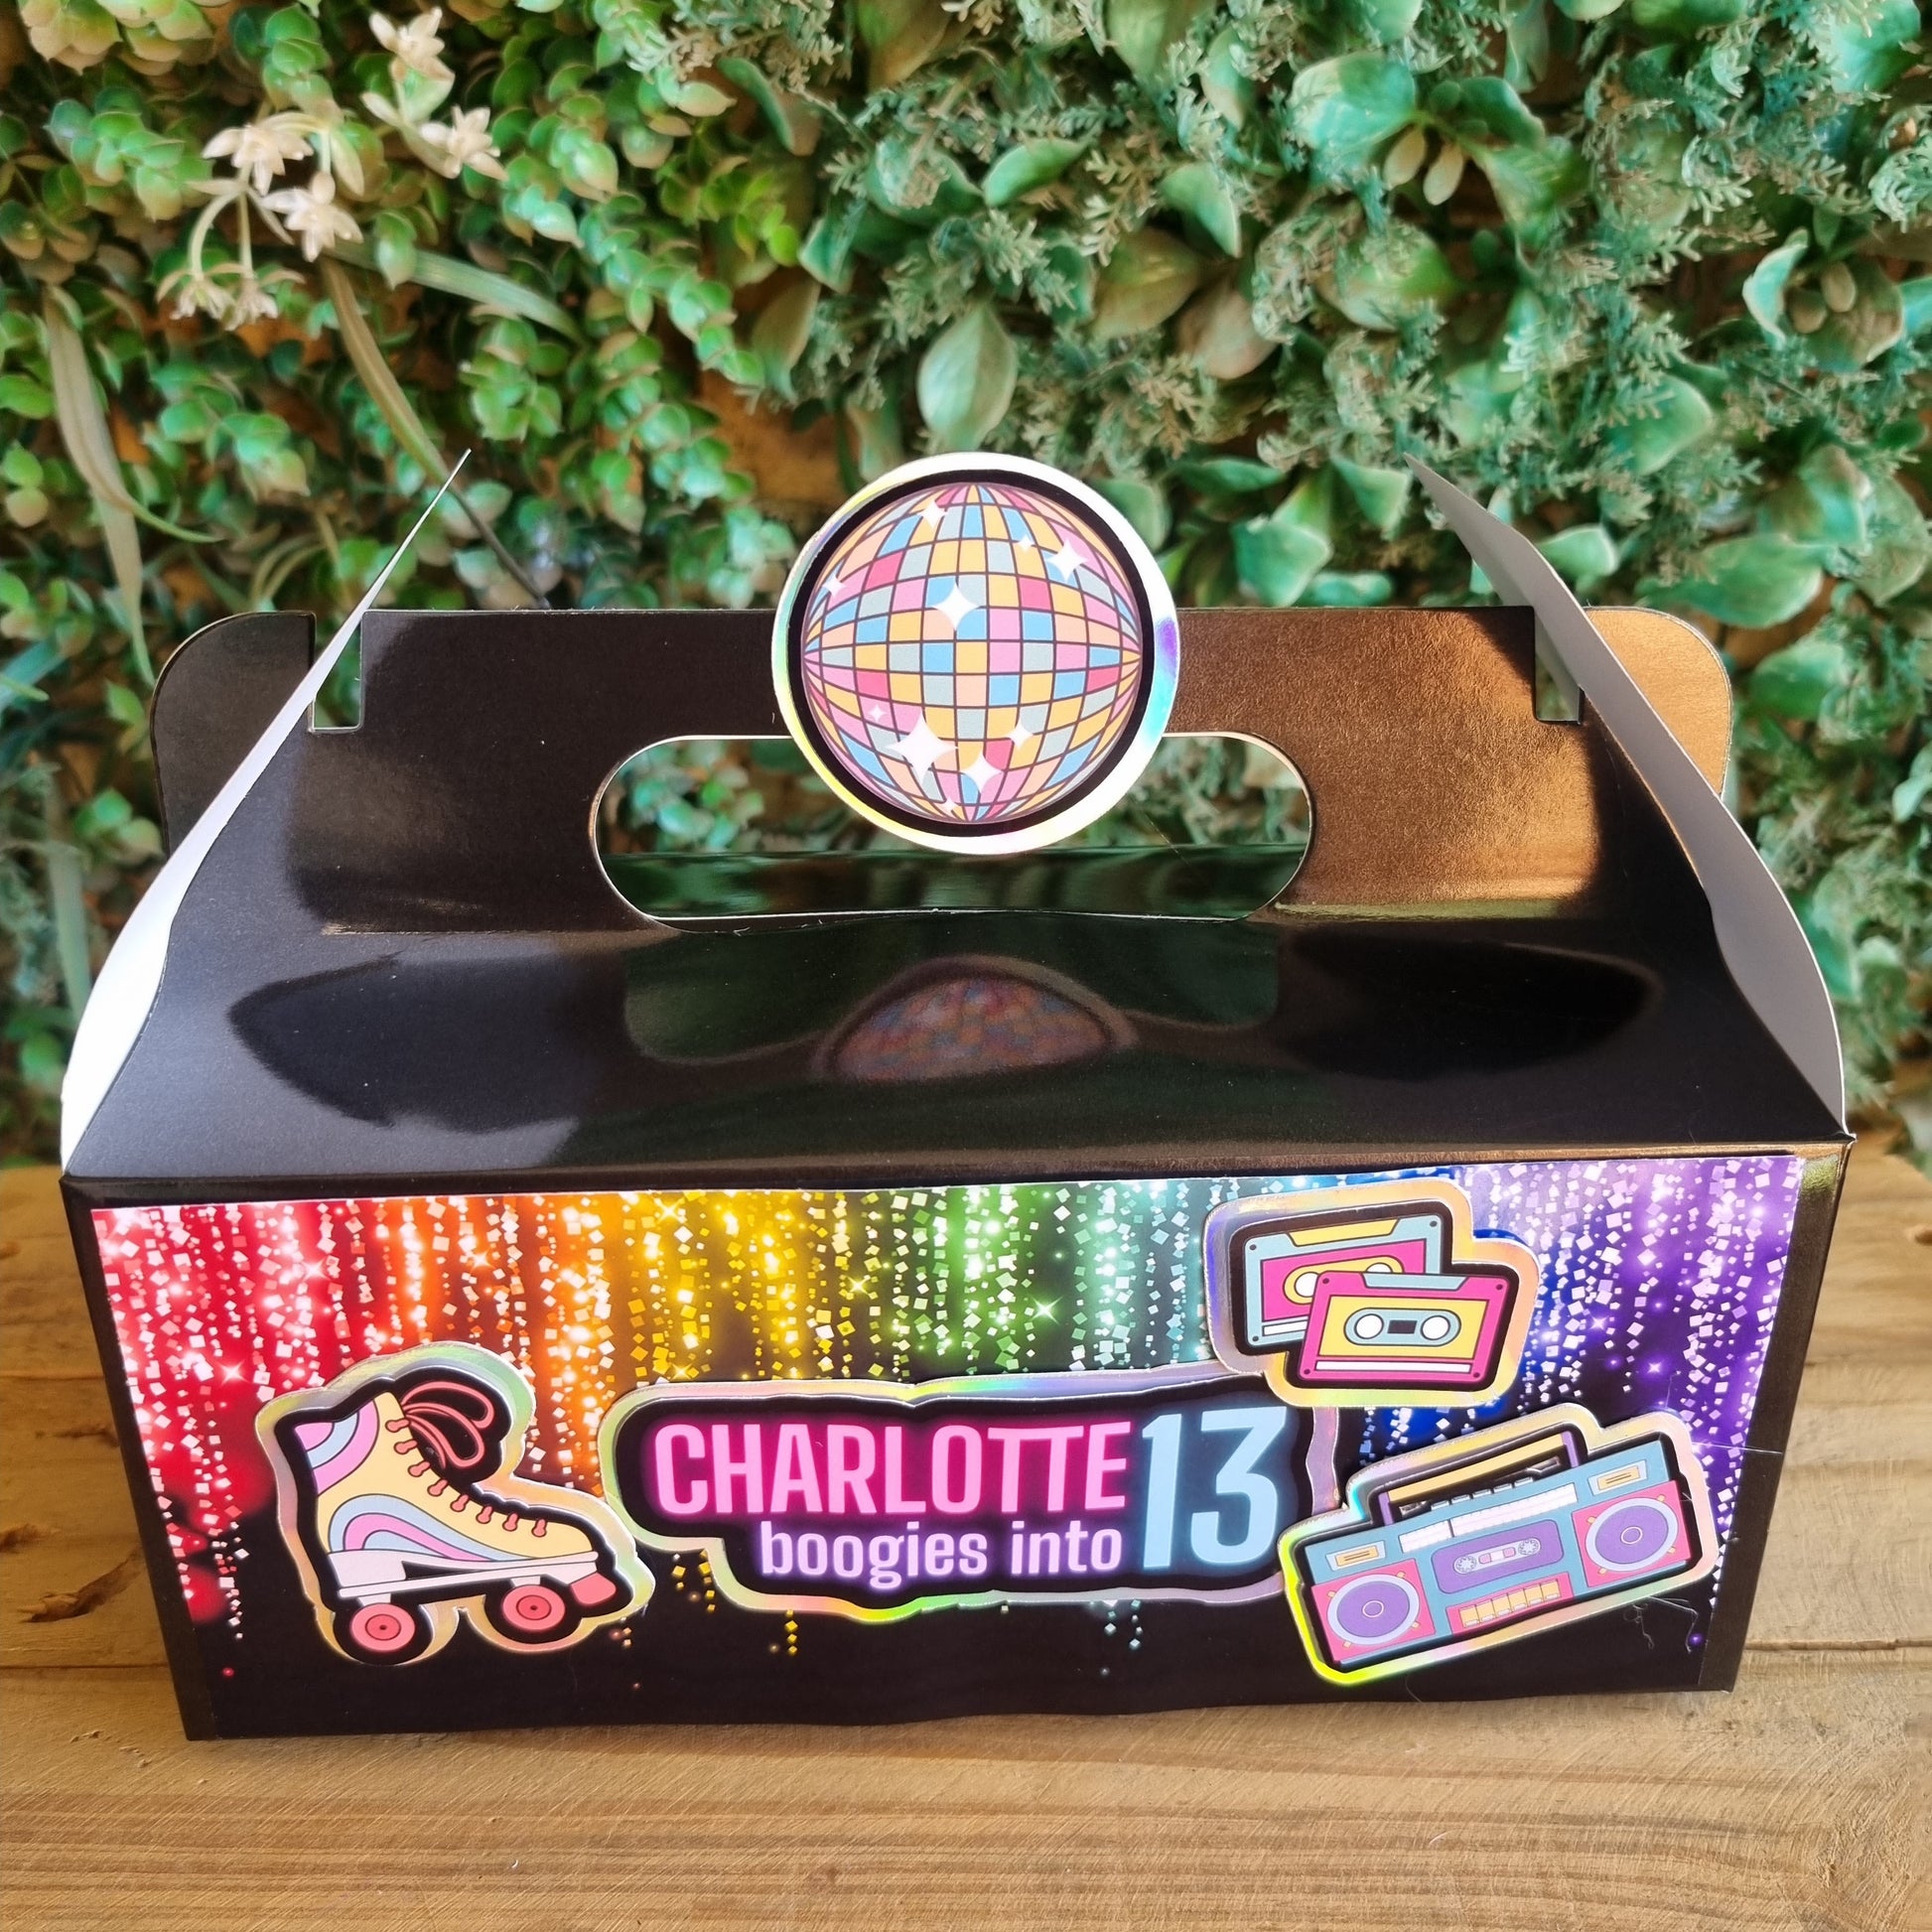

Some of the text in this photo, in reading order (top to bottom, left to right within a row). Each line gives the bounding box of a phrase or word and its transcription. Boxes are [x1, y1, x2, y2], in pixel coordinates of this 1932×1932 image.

[654, 1421, 1132, 1515] CHARLOTTE
[1141, 1407, 1288, 1570] 13
[760, 1521, 1121, 1587] boogies into
